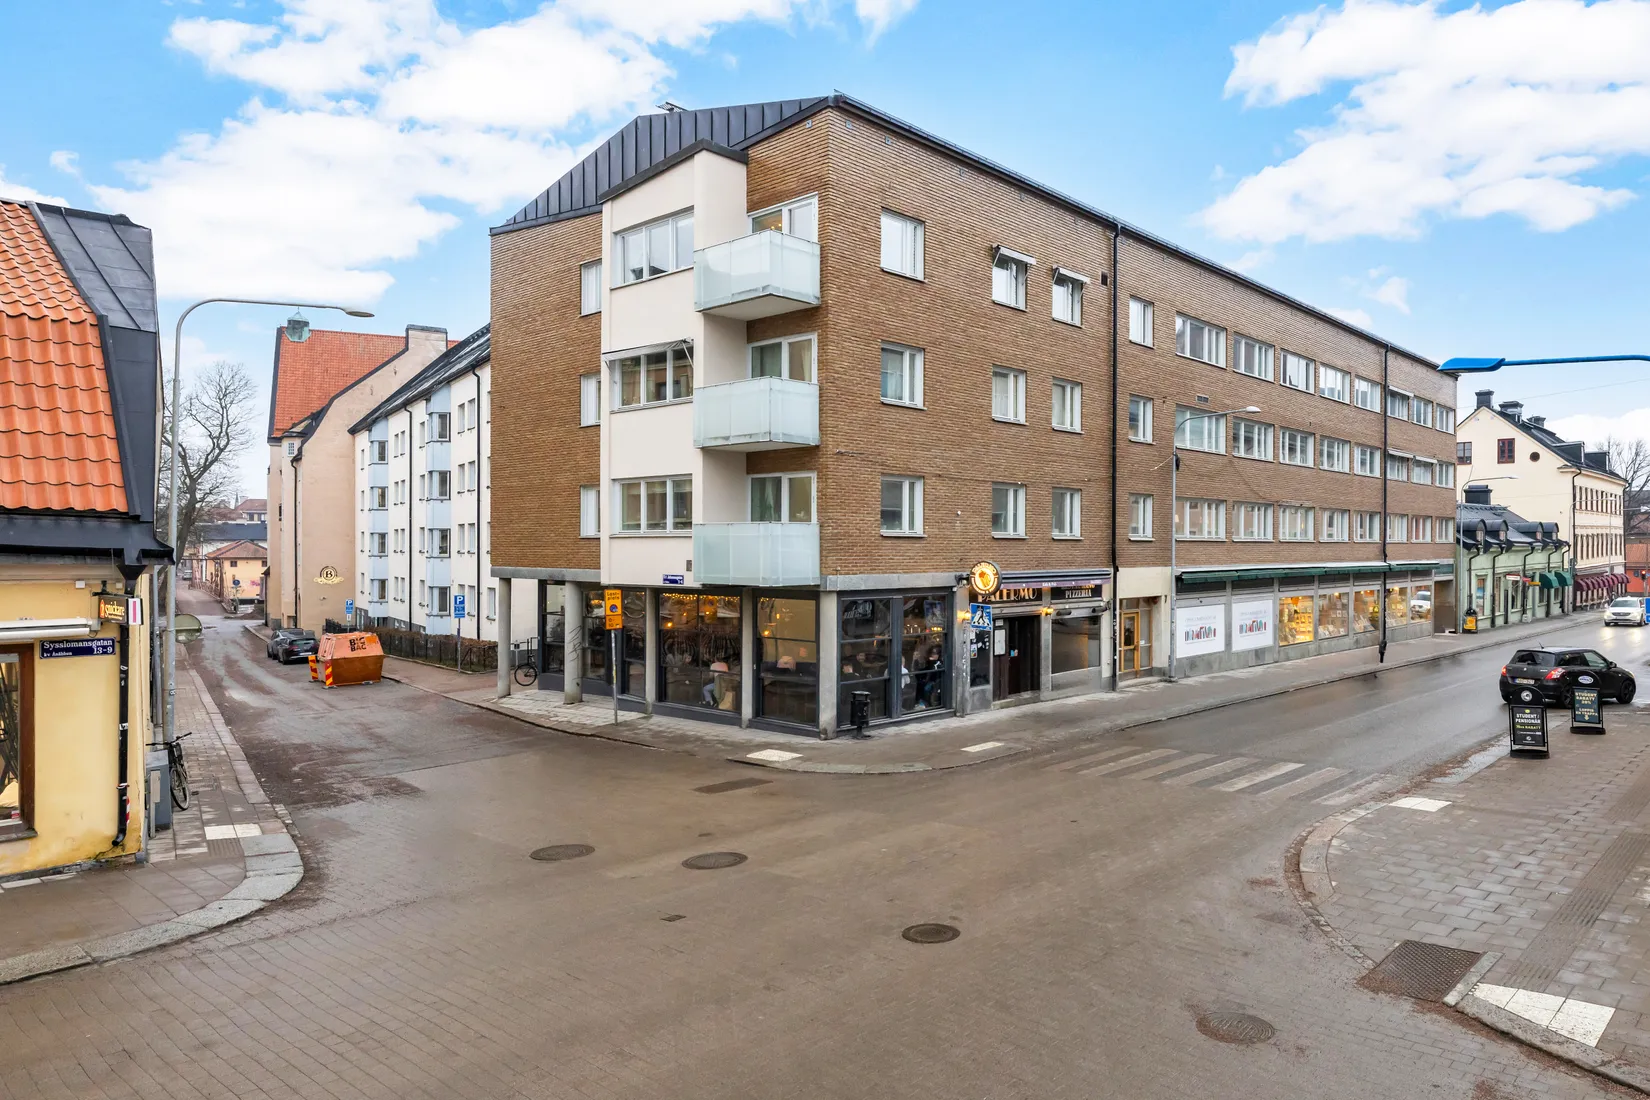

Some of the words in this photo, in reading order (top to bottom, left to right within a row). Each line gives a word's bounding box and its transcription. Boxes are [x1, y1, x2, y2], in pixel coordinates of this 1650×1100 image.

[1066, 590, 1092, 599] PIZZERIA
[457, 596, 463, 604] P
[44, 640, 112, 650] Sysslomansgatan
